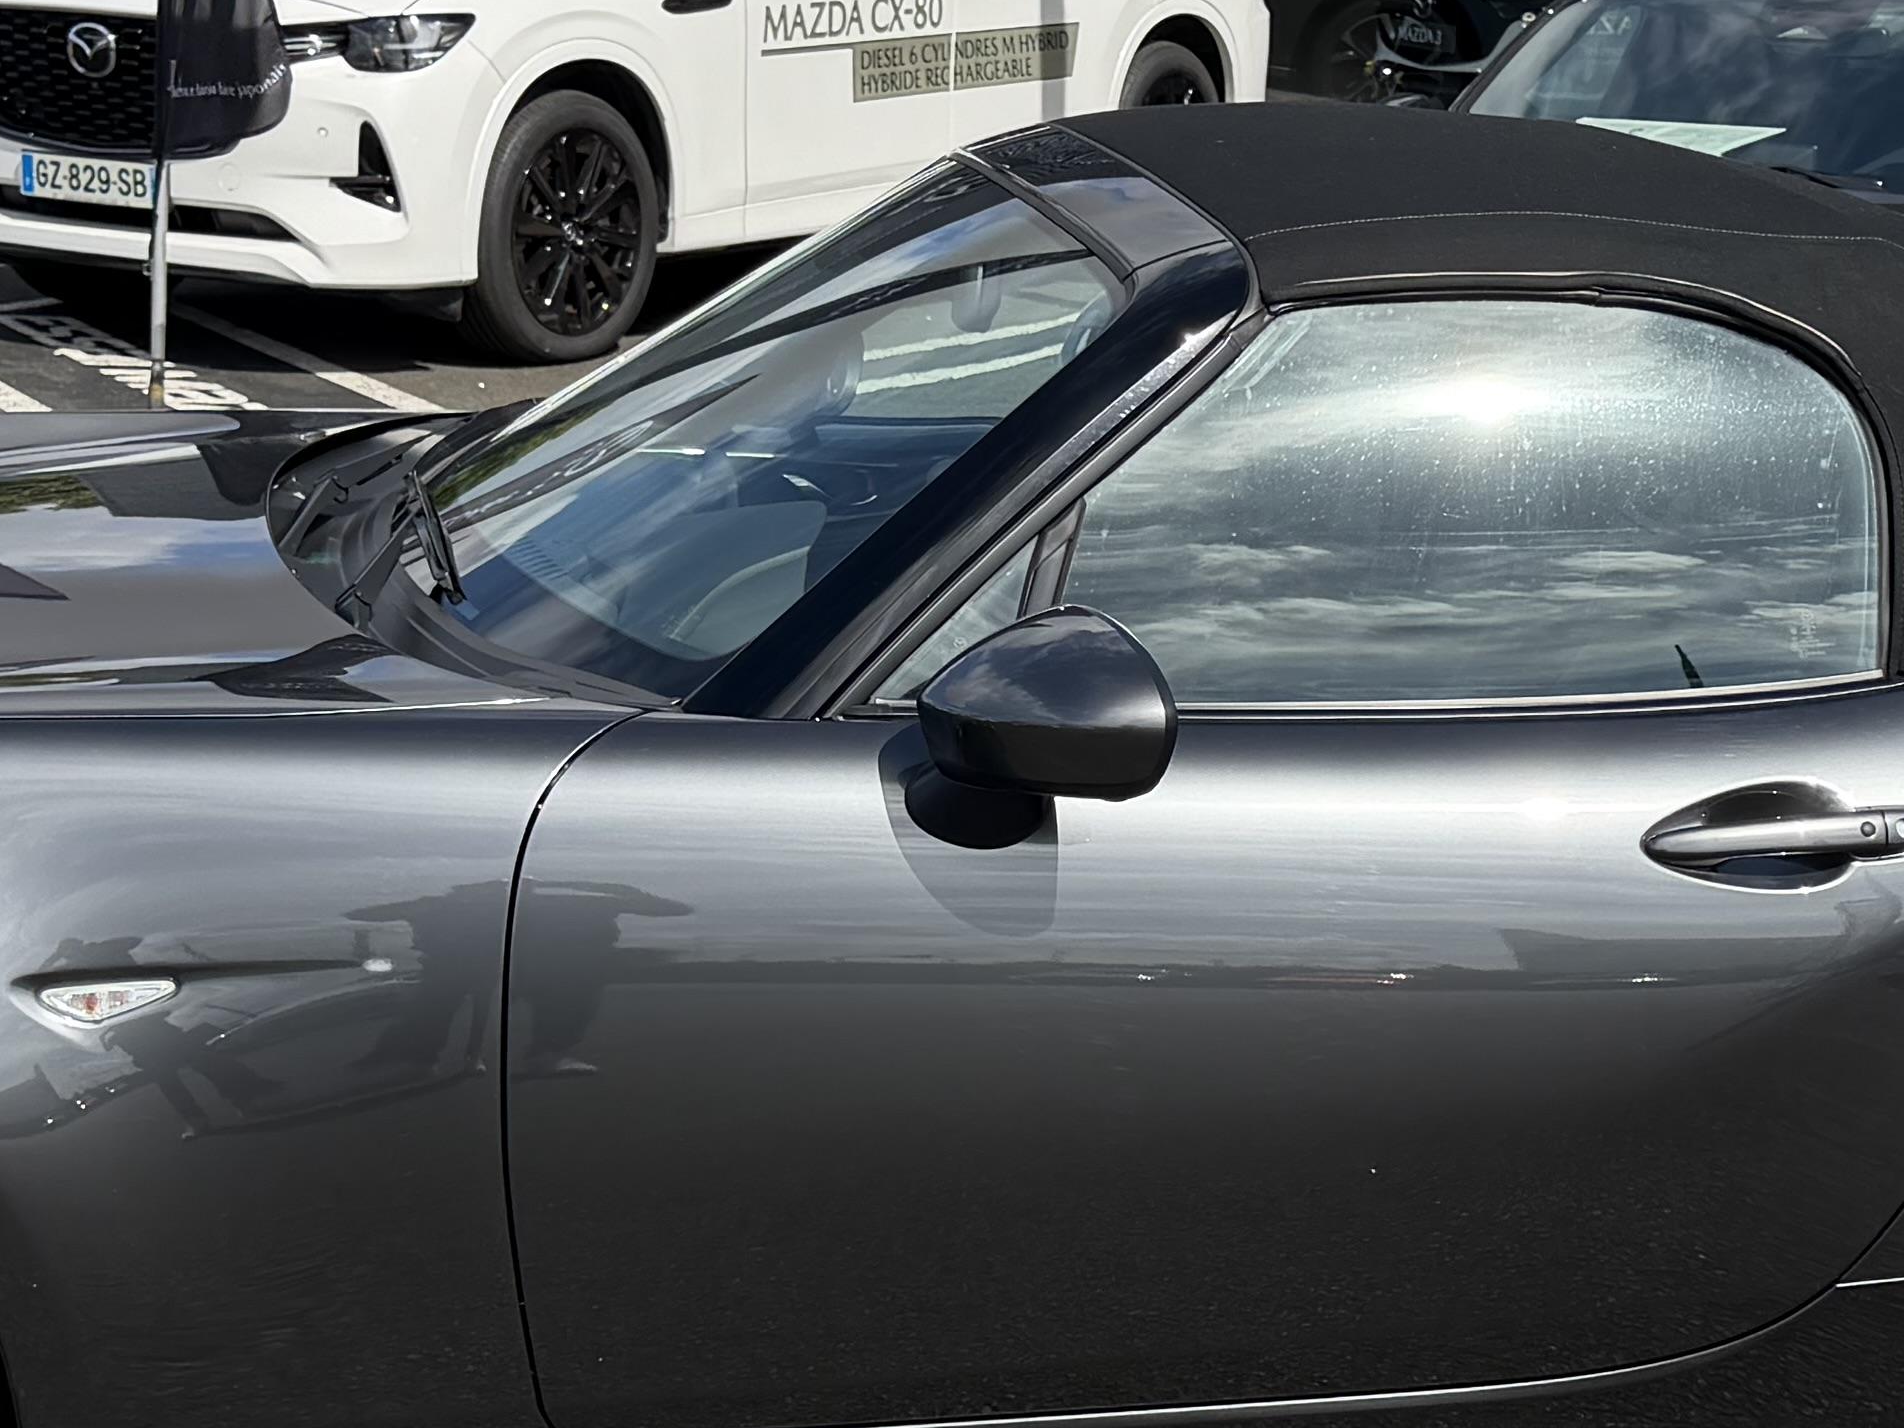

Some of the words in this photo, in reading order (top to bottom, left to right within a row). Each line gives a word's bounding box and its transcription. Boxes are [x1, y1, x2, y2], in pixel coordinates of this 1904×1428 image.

[763, 0, 864, 43] MAZDA
[861, 44, 905, 70] DIESEL
[909, 45, 918, 65] 6
[920, 38, 998, 65] CYLINDRES
[1019, 30, 1070, 53] HYBRID
[861, 70, 922, 95] HYBRIDE
[926, 57, 1033, 86] RECHARGEABLE
[35, 158, 147, 198] GZ-829-SB
